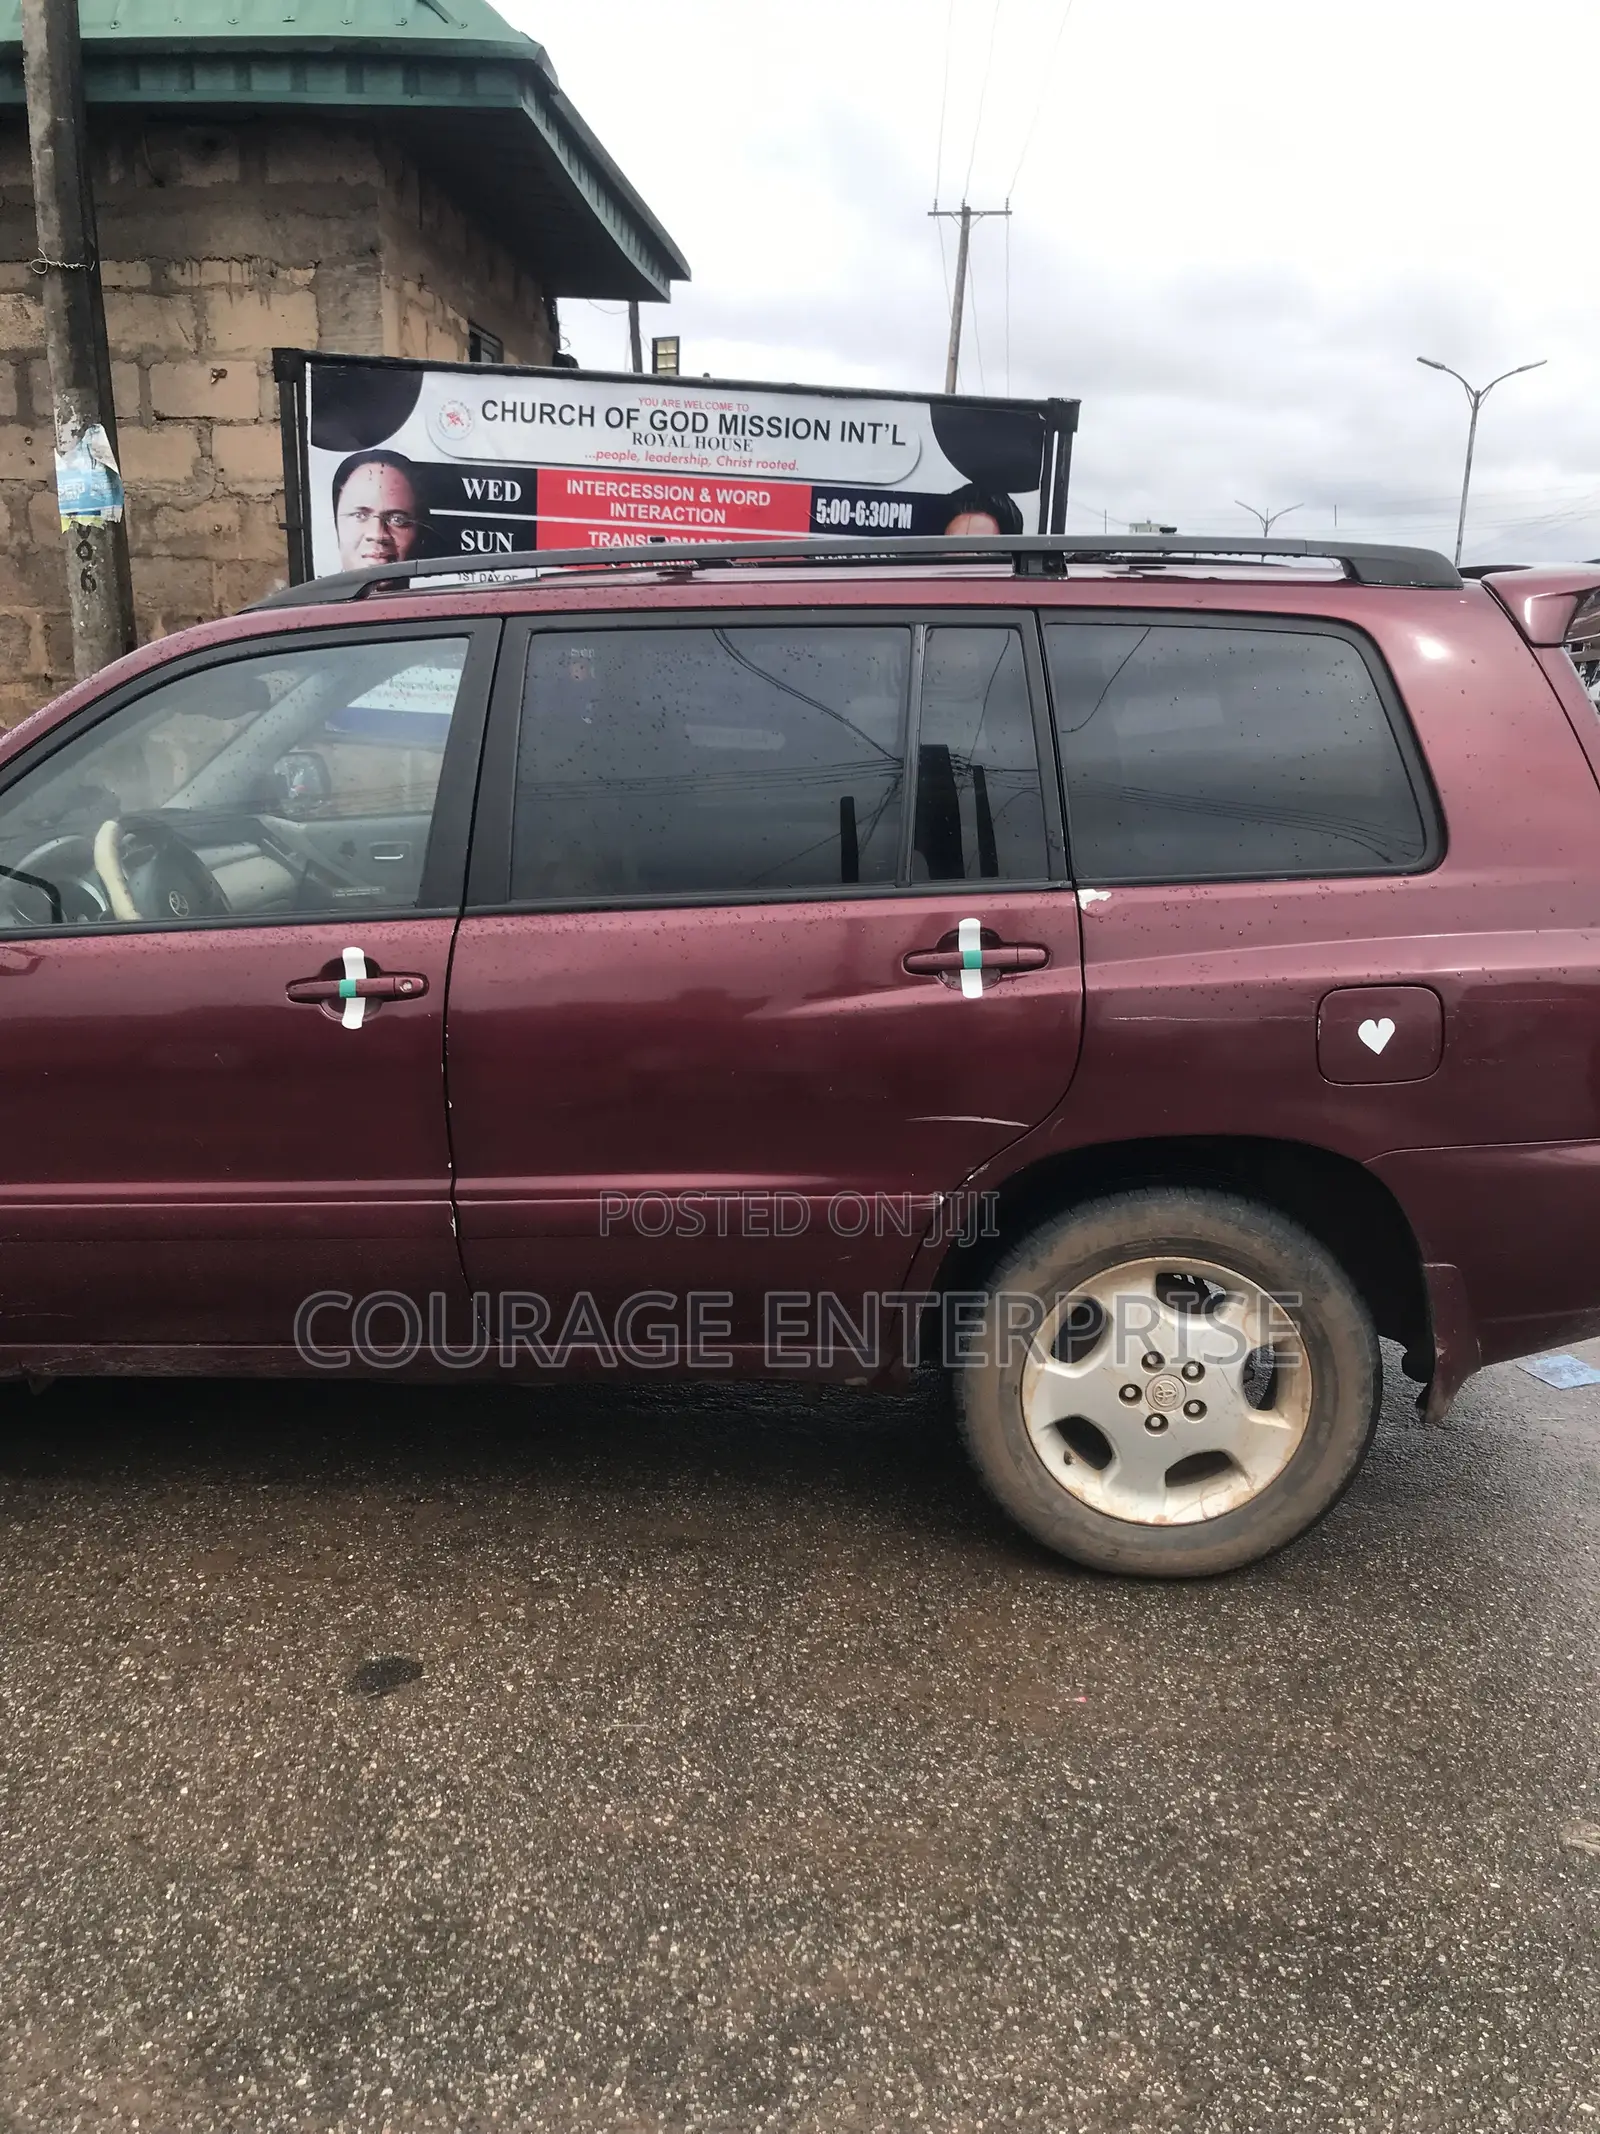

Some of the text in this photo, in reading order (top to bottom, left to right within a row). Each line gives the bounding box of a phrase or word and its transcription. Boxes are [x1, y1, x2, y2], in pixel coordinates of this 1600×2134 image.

[639, 398, 750, 412] YOU ARE WELCOME TO
[481, 399, 595, 428] CHURCH
[605, 406, 640, 430] OF
[650, 409, 709, 433] GOD
[719, 413, 830, 442] MISSION
[840, 420, 906, 446] INT'L
[632, 432, 753, 452] ROYAL HOUSE
[645, 450, 712, 468] leadership,
[716, 455, 753, 469] Christ
[756, 459, 799, 472] rooted.
[461, 477, 522, 502] WED
[566, 479, 771, 506] INTERCESSION & WORD
[610, 502, 726, 524] INTERACTION
[816, 497, 913, 529] 5:00-6:30PM
[460, 529, 514, 553] SUN
[480, 571, 503, 583] DAY
